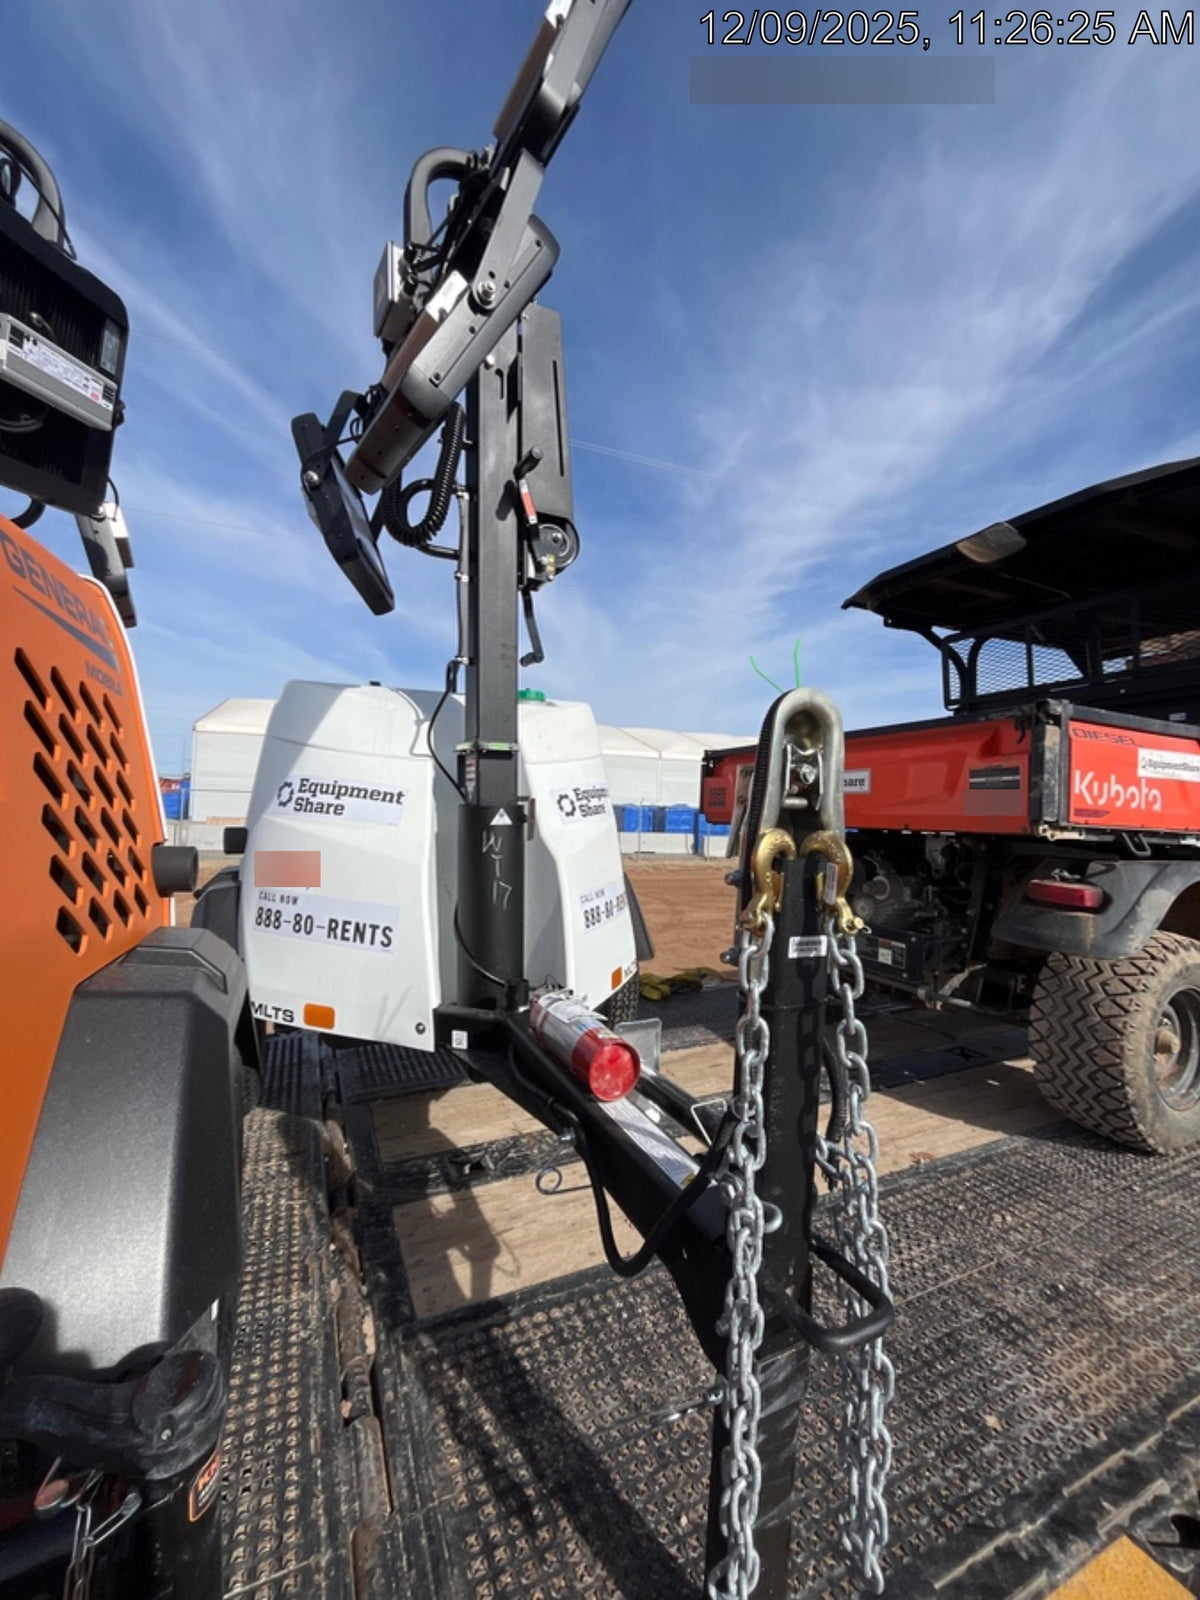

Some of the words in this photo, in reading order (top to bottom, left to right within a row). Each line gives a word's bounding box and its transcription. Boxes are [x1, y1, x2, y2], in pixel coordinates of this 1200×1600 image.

[0, 528, 114, 650] GENERAC
[297, 777, 406, 805] Equipment
[1074, 769, 1163, 811] Kubota
[293, 797, 345, 815] Share
[258, 890, 276, 904] CALL
[255, 906, 394, 948] 888-80-RENTS
[250, 1001, 295, 1023] MLTS
